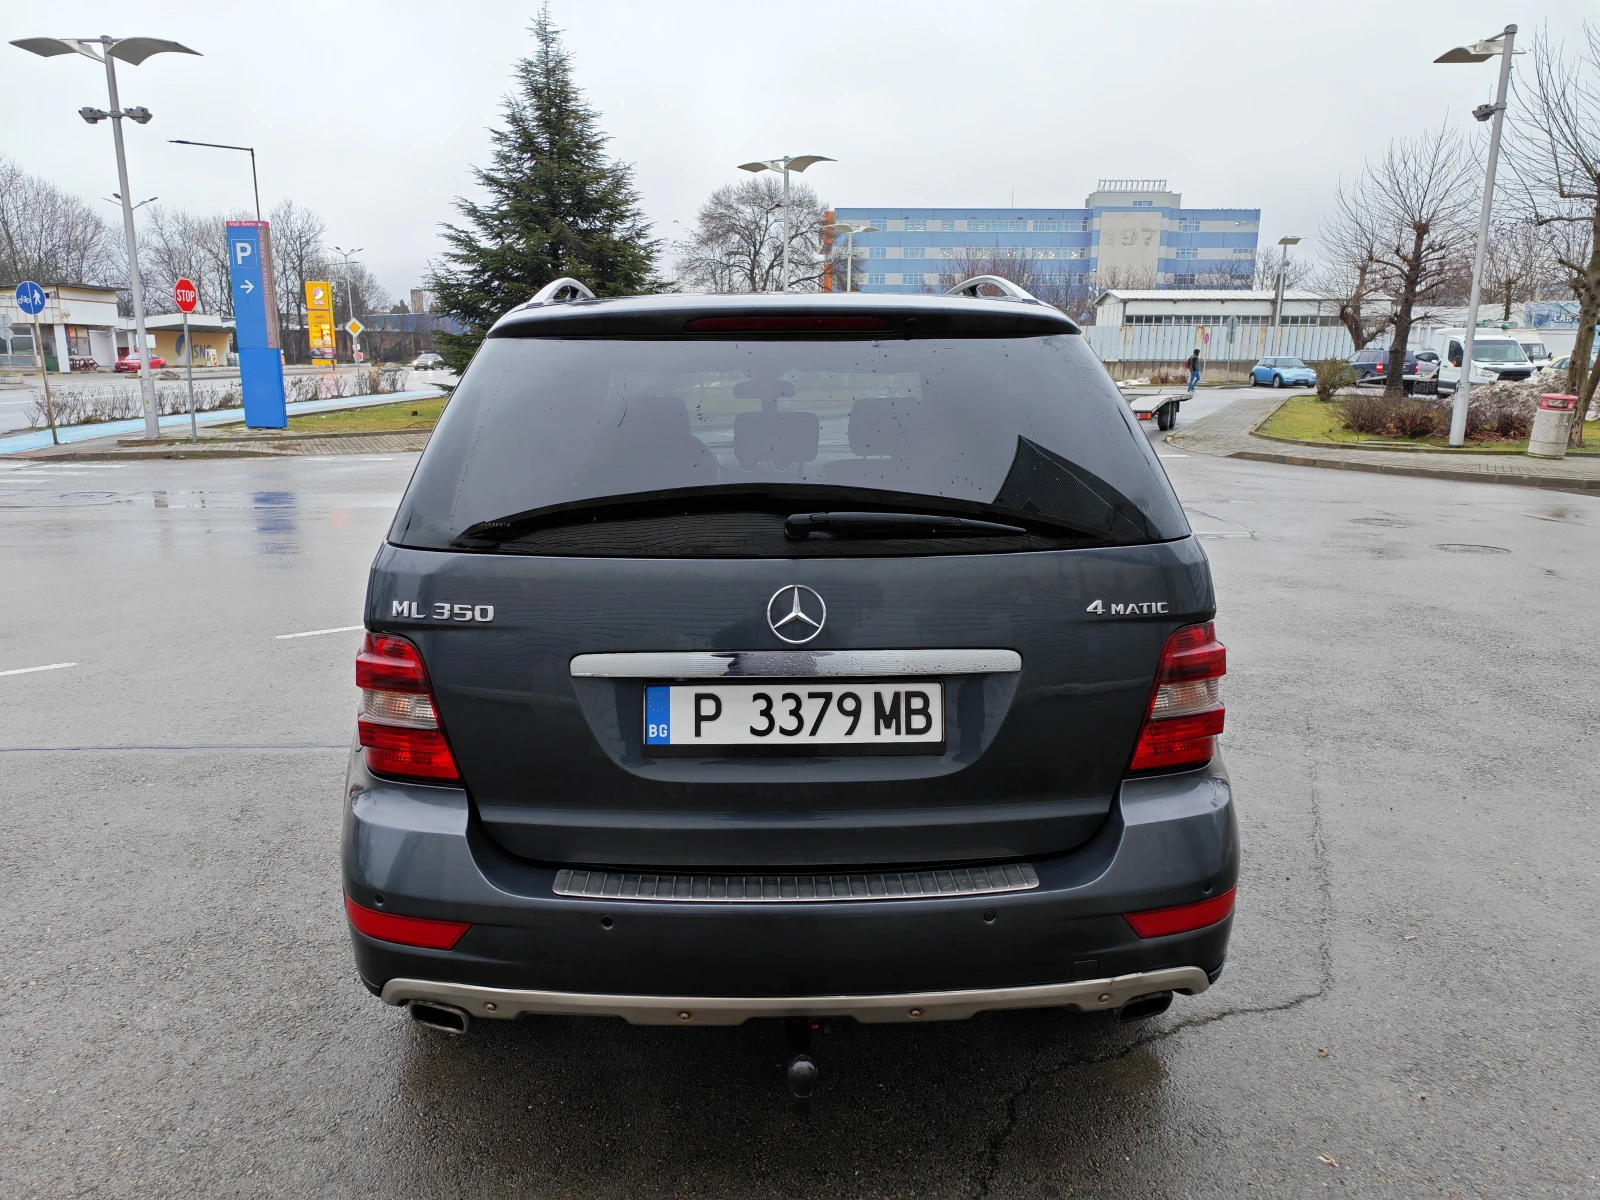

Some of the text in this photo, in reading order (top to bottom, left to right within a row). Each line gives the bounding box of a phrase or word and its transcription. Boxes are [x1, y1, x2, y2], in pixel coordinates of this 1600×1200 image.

[235, 242, 252, 265] P
[176, 289, 195, 302] STOP
[192, 344, 212, 358] SN
[391, 600, 495, 622] ML 350
[1086, 599, 1169, 615] 4 MATIC
[694, 690, 933, 738] P 3379 MB
[648, 724, 668, 737] BG
